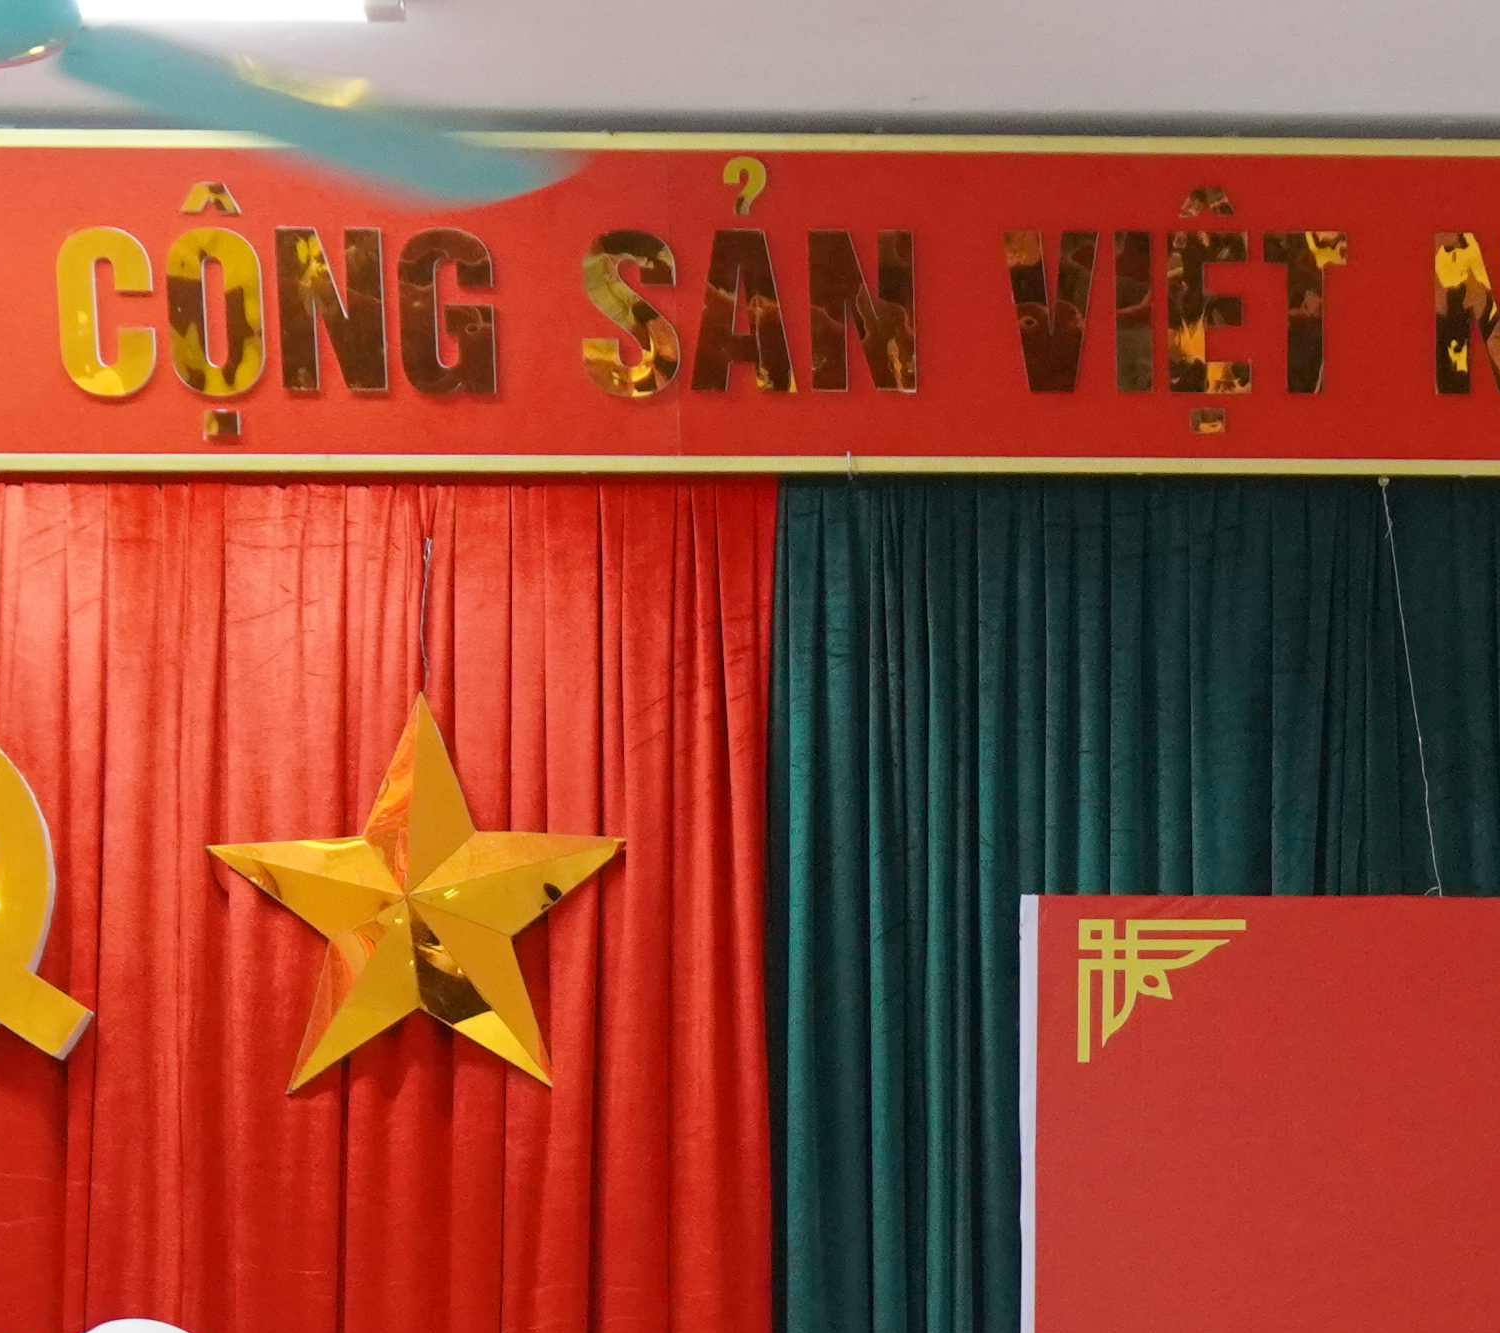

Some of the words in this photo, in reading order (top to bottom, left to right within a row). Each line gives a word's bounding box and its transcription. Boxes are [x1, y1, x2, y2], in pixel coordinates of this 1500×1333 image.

[56, 181, 496, 439] CỘNG
[581, 156, 918, 397] SẢN
[1003, 187, 1347, 434] VIỆT
